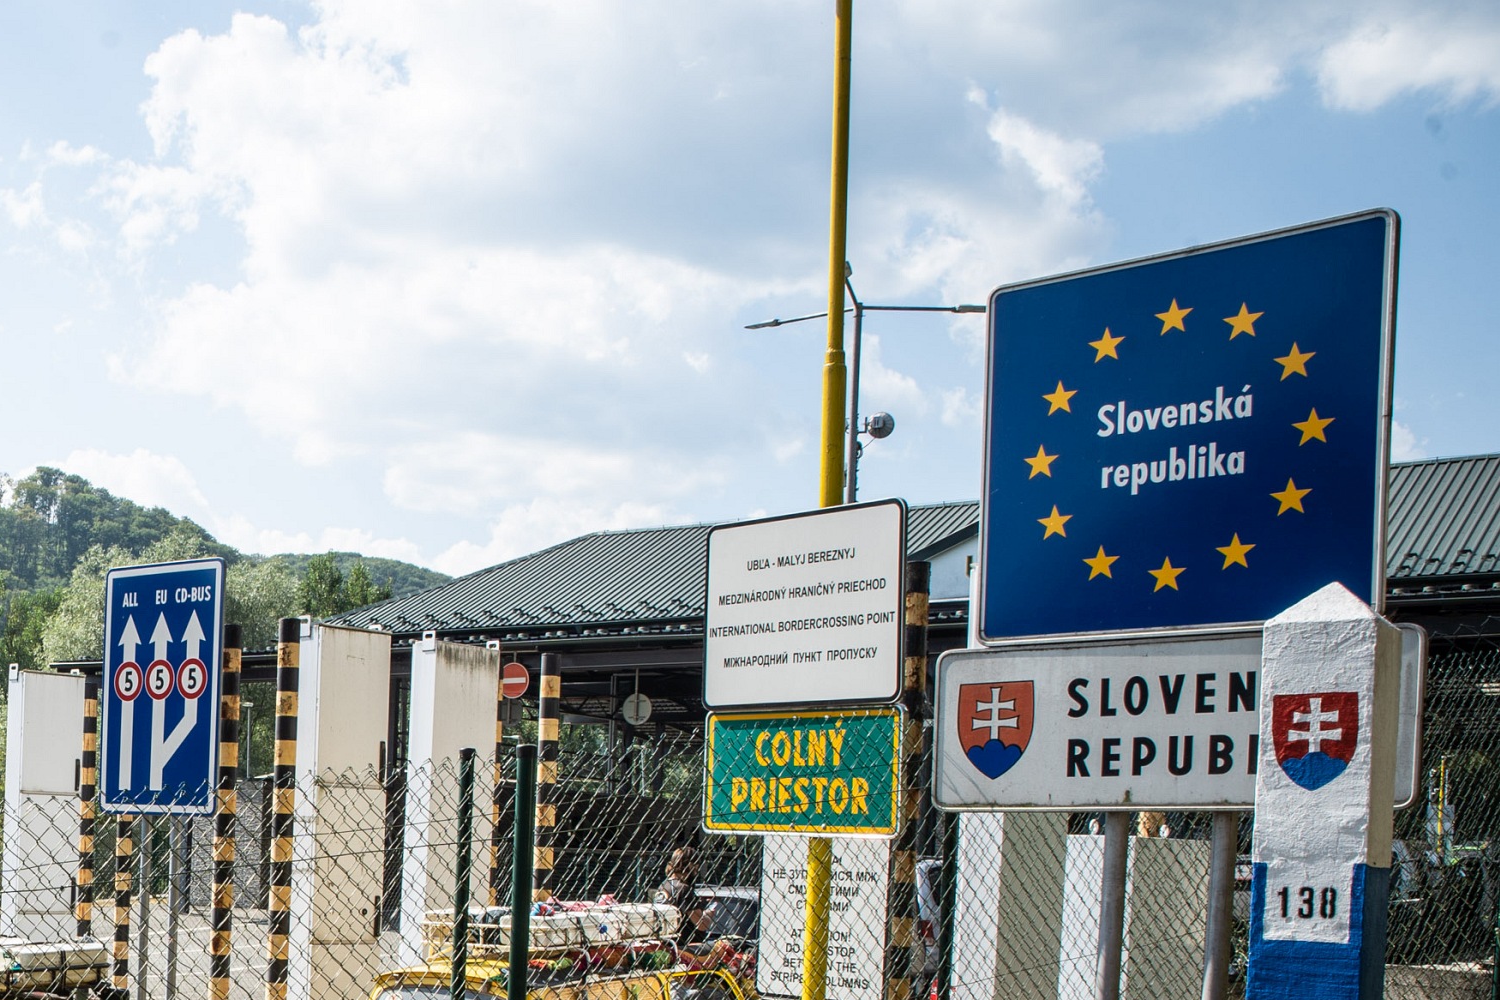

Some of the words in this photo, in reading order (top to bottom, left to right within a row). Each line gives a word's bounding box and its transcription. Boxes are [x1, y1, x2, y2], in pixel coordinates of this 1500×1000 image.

[1096, 385, 1254, 438] Slovenská
[1101, 449, 1246, 495] republika
[747, 558, 771, 571] UBĽA
[777, 553, 806, 568] MALYJ
[807, 548, 856, 564] BEREZNYJ
[122, 592, 139, 608] ALL
[155, 589, 168, 605] EU
[174, 585, 212, 603] CD-BUS
[718, 587, 787, 606] MEDZINÁRODNÝ
[788, 582, 835, 599] HRANIČNÝ
[837, 577, 887, 593] PRIECHOD
[709, 621, 777, 638] INTERNATIONAL
[778, 614, 865, 634] BORDERCROSSING
[866, 611, 896, 626] POINT
[723, 652, 788, 669] МІЖНАРОДНИЙ
[792, 650, 822, 664] ПУНКТ
[826, 646, 878, 661] ПРОПУСКУ
[124, 671, 134, 692] 5
[155, 669, 164, 690] 5
[187, 668, 197, 689] 5
[1067, 671, 1257, 718] SLOVEN
[755, 719, 847, 768] COLNÝ
[1067, 736, 1257, 778] REPUB
[730, 776, 869, 816] PRIESTOR
[1276, 886, 1337, 920] 138
[836, 962, 857, 973] THE
[825, 975, 870, 990] OLUMNS
